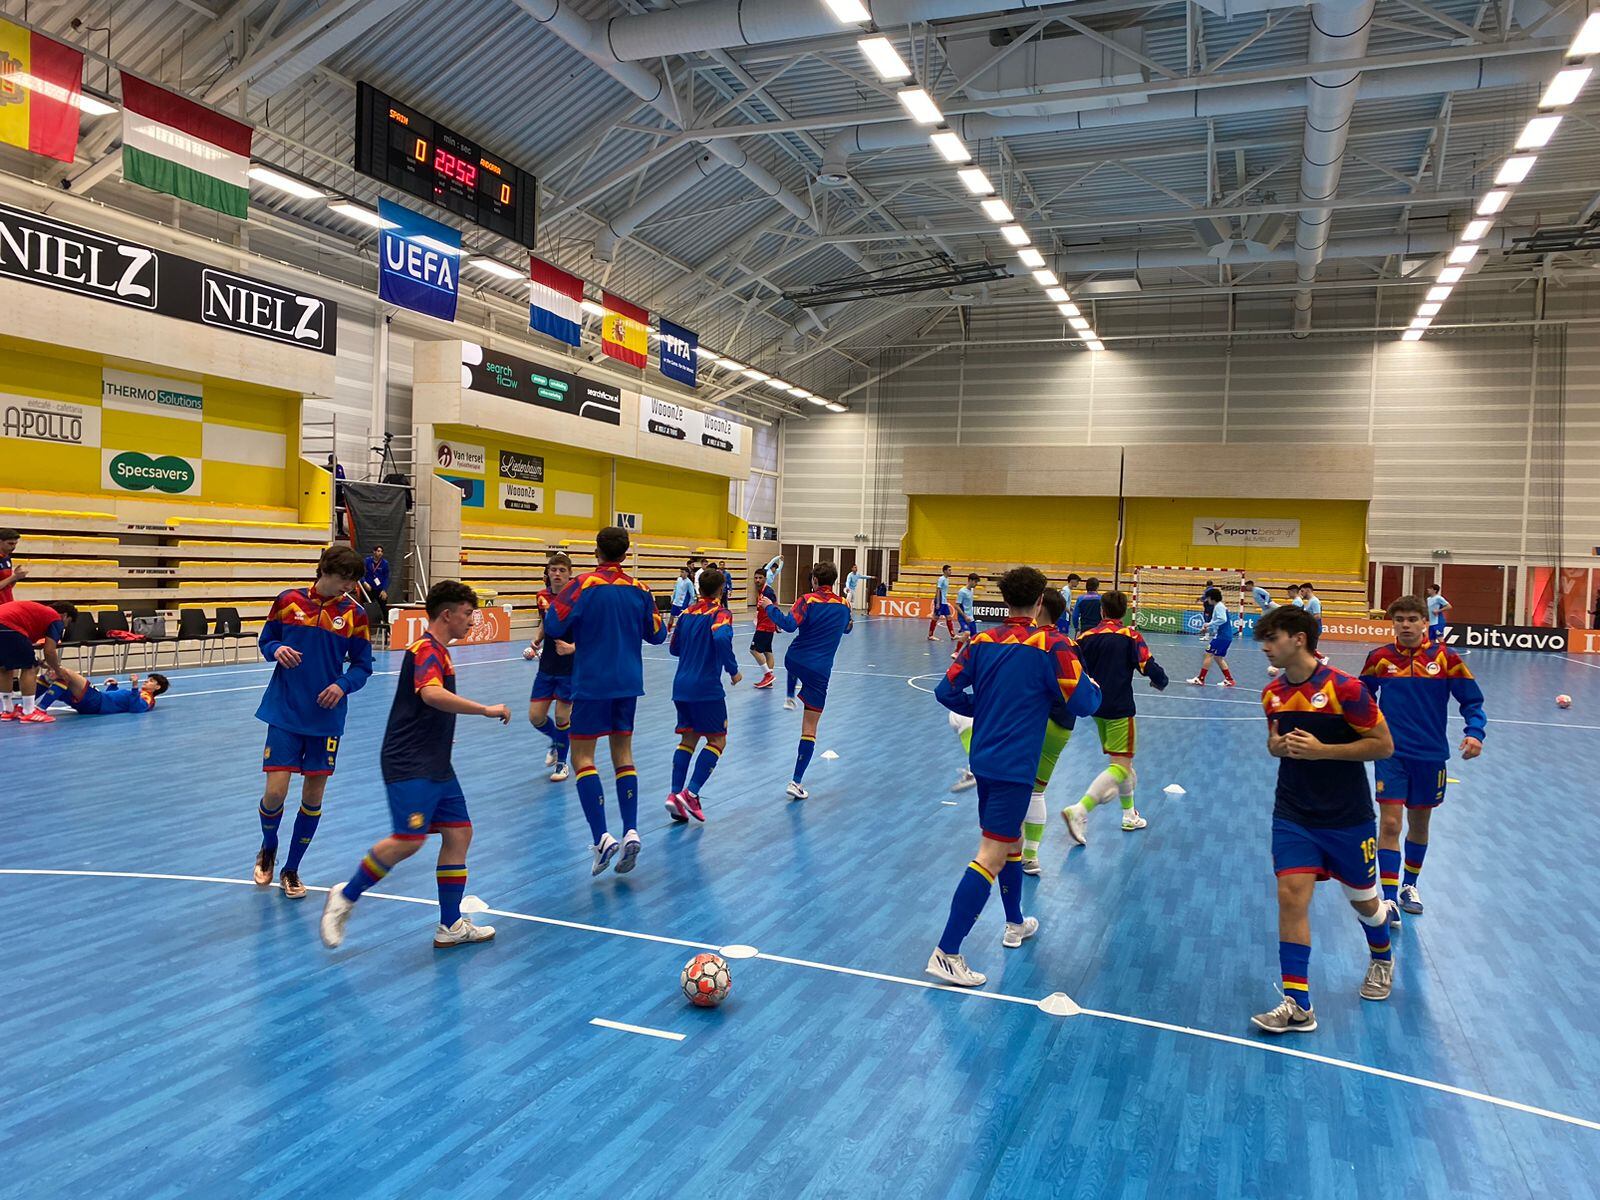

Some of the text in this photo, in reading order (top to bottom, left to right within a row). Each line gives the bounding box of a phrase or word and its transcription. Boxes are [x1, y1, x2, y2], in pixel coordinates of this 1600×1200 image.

[389, 108, 409, 125] SPAIN
[415, 138, 427, 162] 0
[443, 135, 456, 147] min
[460, 144, 472, 155] sec
[500, 183, 511, 204] 0
[385, 235, 454, 291] UEFA
[205, 279, 321, 341] NIELZ
[667, 333, 691, 361] FIFA
[486, 362, 513, 377] search
[496, 374, 518, 389] flow
[106, 383, 202, 409] THERMO Solutions
[3, 405, 82, 441] APOLLO
[453, 449, 484, 464] Van Iersel
[117, 462, 188, 480] Specsavers
[1224, 527, 1296, 538] sportbedrijf
[879, 599, 921, 617] ING
[971, 606, 1009, 617] IKEFOOTB
[1150, 613, 1176, 626] kpn
[1322, 623, 1395, 636] aatsloteri
[1466, 626, 1565, 650] bitvavo
[326, 736, 338, 752] 6
[1437, 769, 1447, 789] 11
